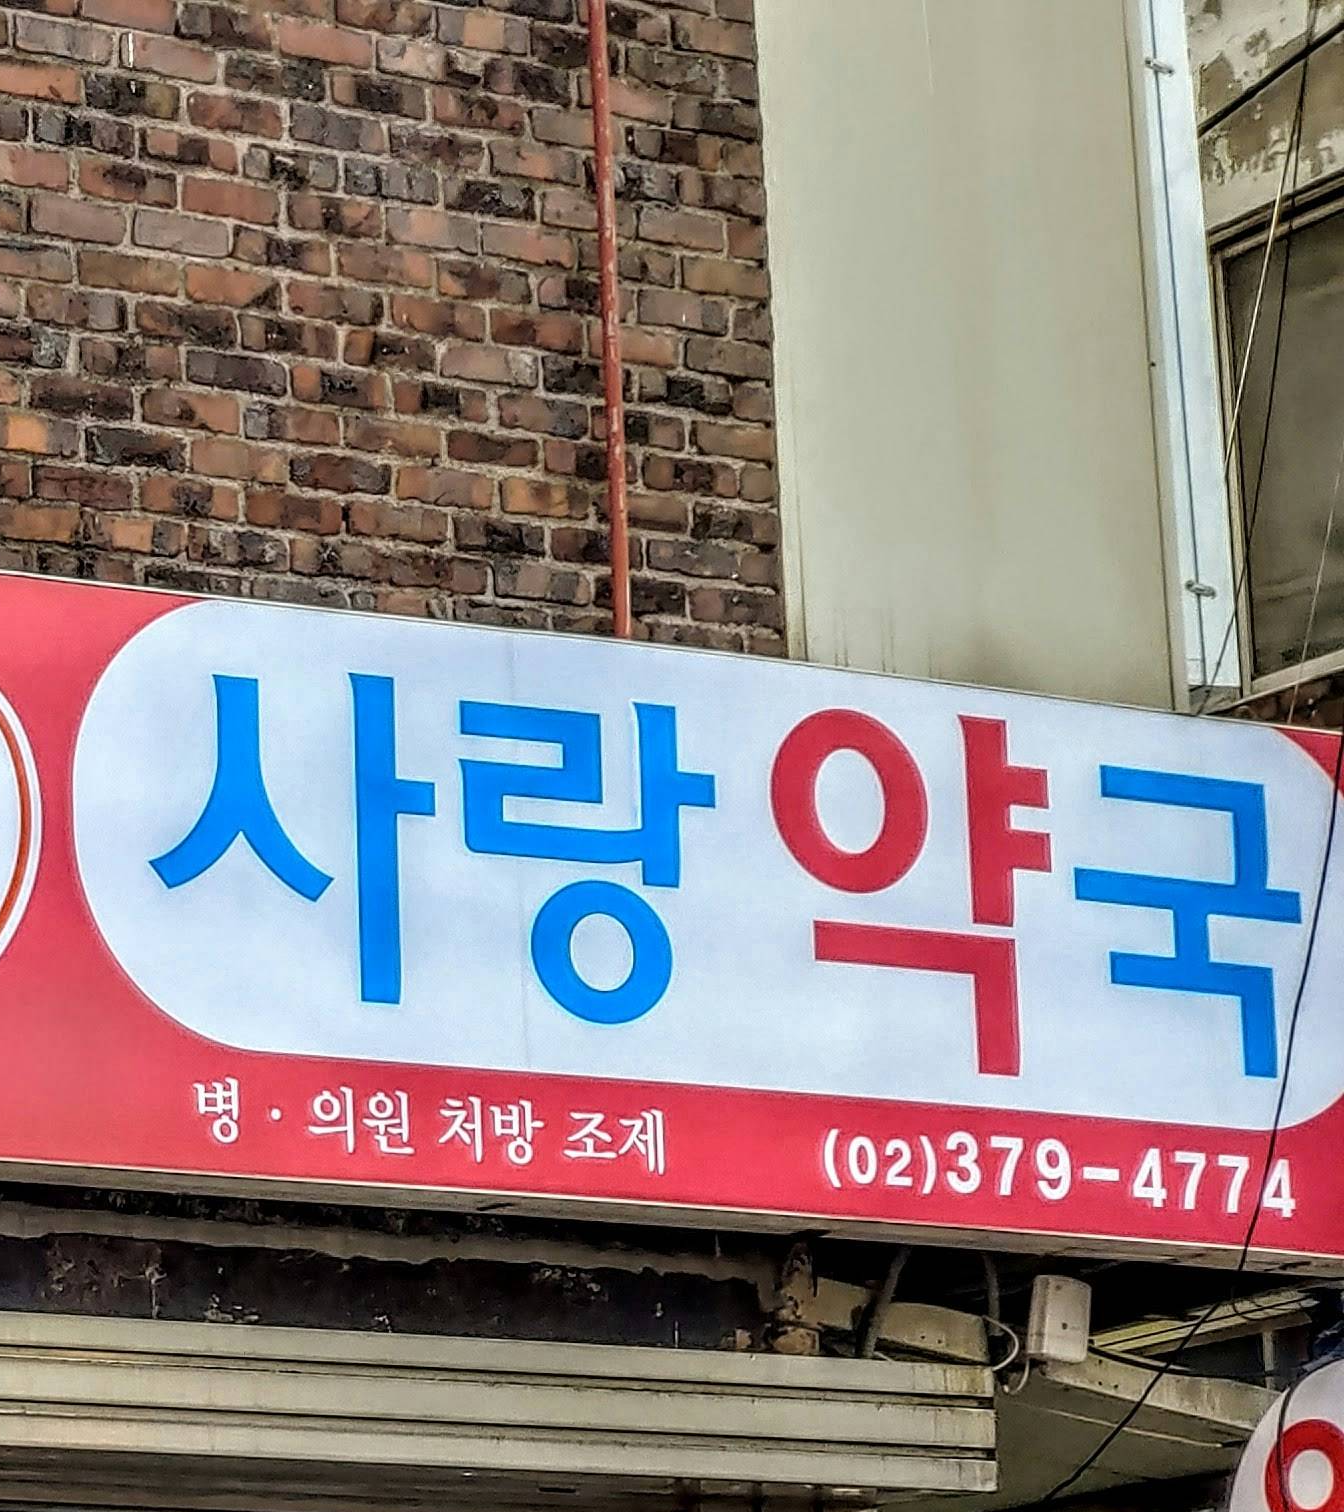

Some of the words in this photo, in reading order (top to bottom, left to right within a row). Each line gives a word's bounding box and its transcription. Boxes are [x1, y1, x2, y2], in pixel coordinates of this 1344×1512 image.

[149, 673, 1302, 1077] 사랑약국
[193, 1079, 240, 1145] 병
[307, 1088, 412, 1156] 의원
[438, 1095, 543, 1168] 처방
[563, 1108, 666, 1176] 조제
[822, 1127, 1296, 1219] (02)379-4774
